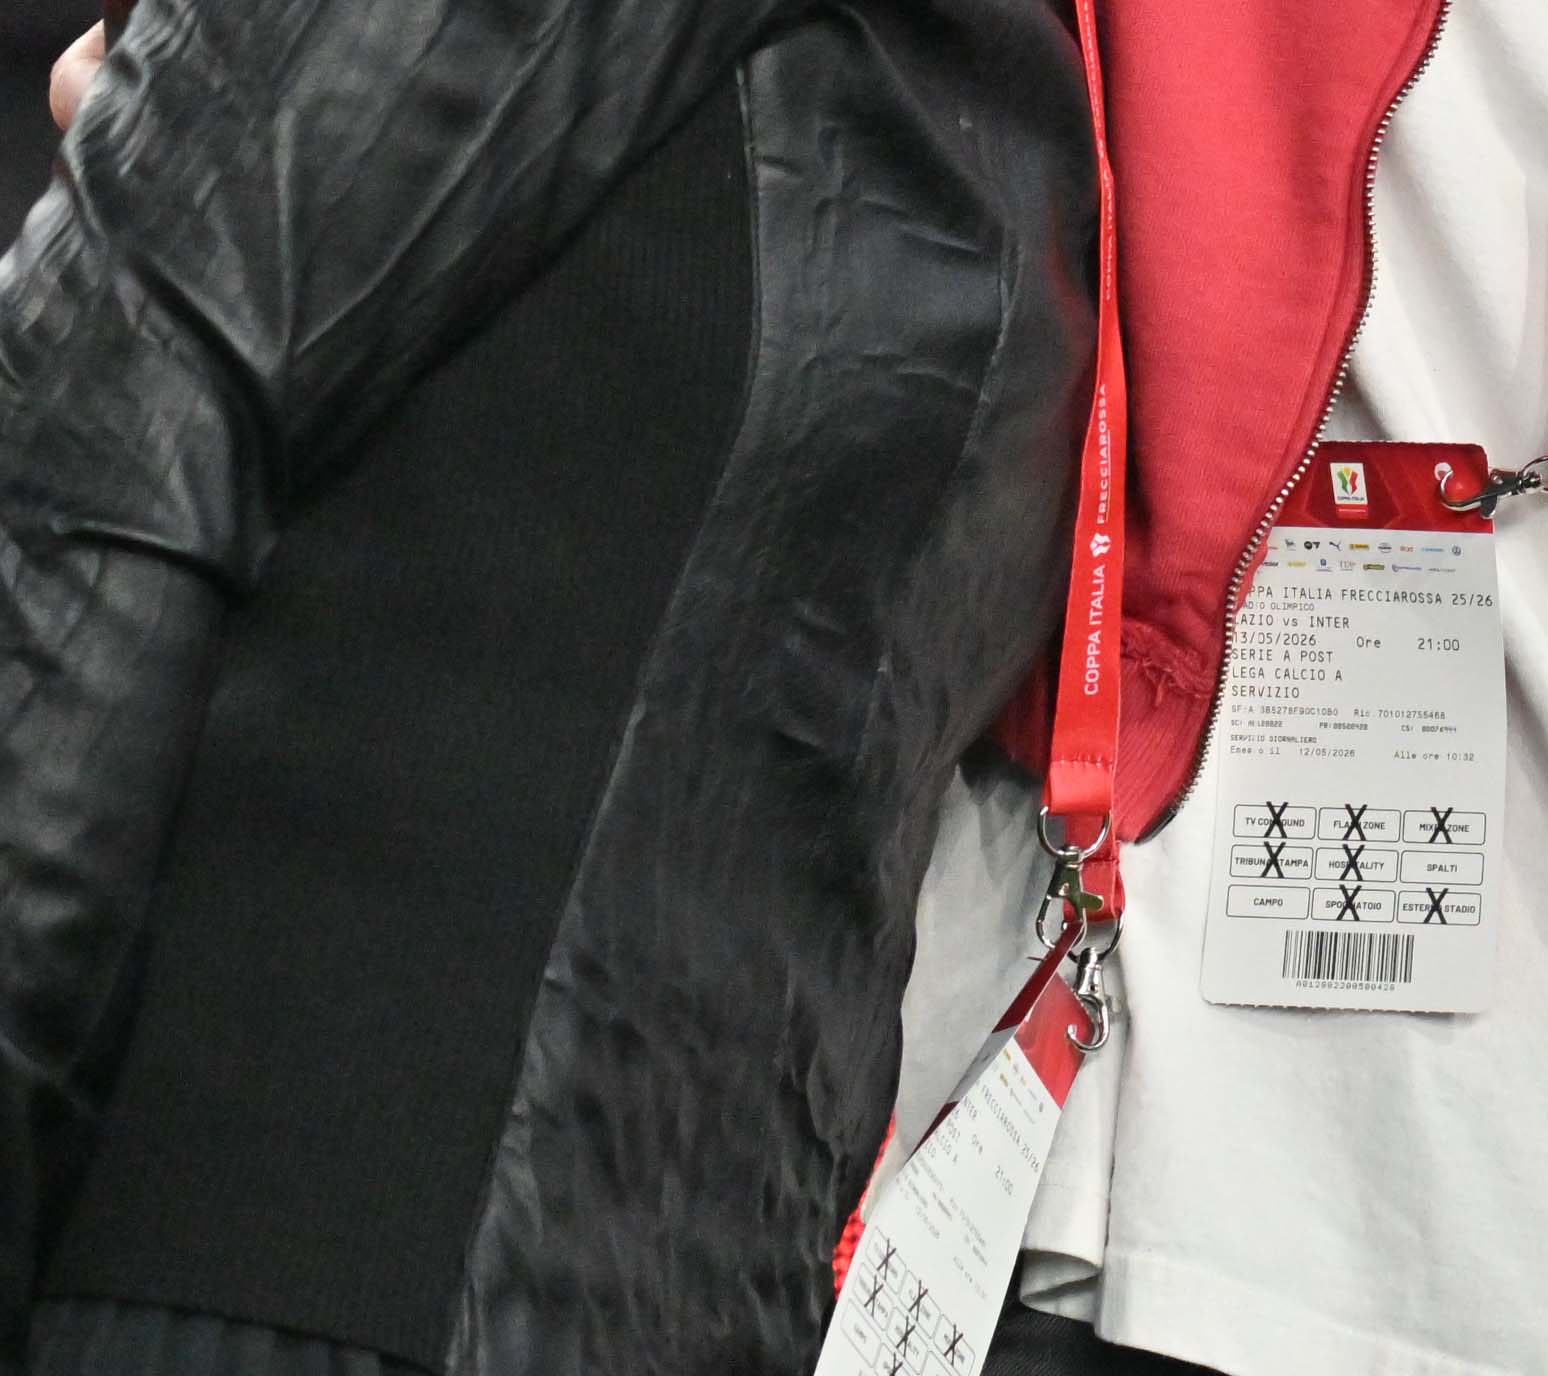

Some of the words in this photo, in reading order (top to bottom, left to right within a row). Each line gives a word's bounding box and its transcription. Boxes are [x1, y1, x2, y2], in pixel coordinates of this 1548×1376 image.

[1097, 384, 1107, 523] FRECCIAROSSA
[1090, 565, 1105, 624] ITALIA
[1249, 586, 1273, 596] PPA
[1284, 588, 1332, 599] ITALIA
[1341, 590, 1442, 604] FRECCIAROSSA
[1452, 594, 1493, 606] 25/26
[1310, 617, 1349, 628] INTER
[1357, 638, 1381, 648] Ore
[1418, 639, 1460, 652] 21:00
[1232, 649, 1272, 661] SERIE
[1300, 652, 1333, 662] POST
[1084, 631, 1100, 694] COPPA
[1232, 668, 1265, 678] LEGA
[1275, 669, 1325, 680] CALCIO
[1232, 686, 1299, 698] SERVIZIO
[1246, 817, 1256, 826] TV
[1333, 821, 1362, 829] FLA
[1363, 821, 1385, 830] ZONE
[1448, 824, 1469, 833] ZONE
[1276, 858, 1308, 867] TAMPA
[1427, 864, 1457, 872] SPALTI
[1253, 898, 1283, 906] CAMPO
[1403, 904, 1443, 912] ESTER
[1445, 905, 1475, 913] STADIO
